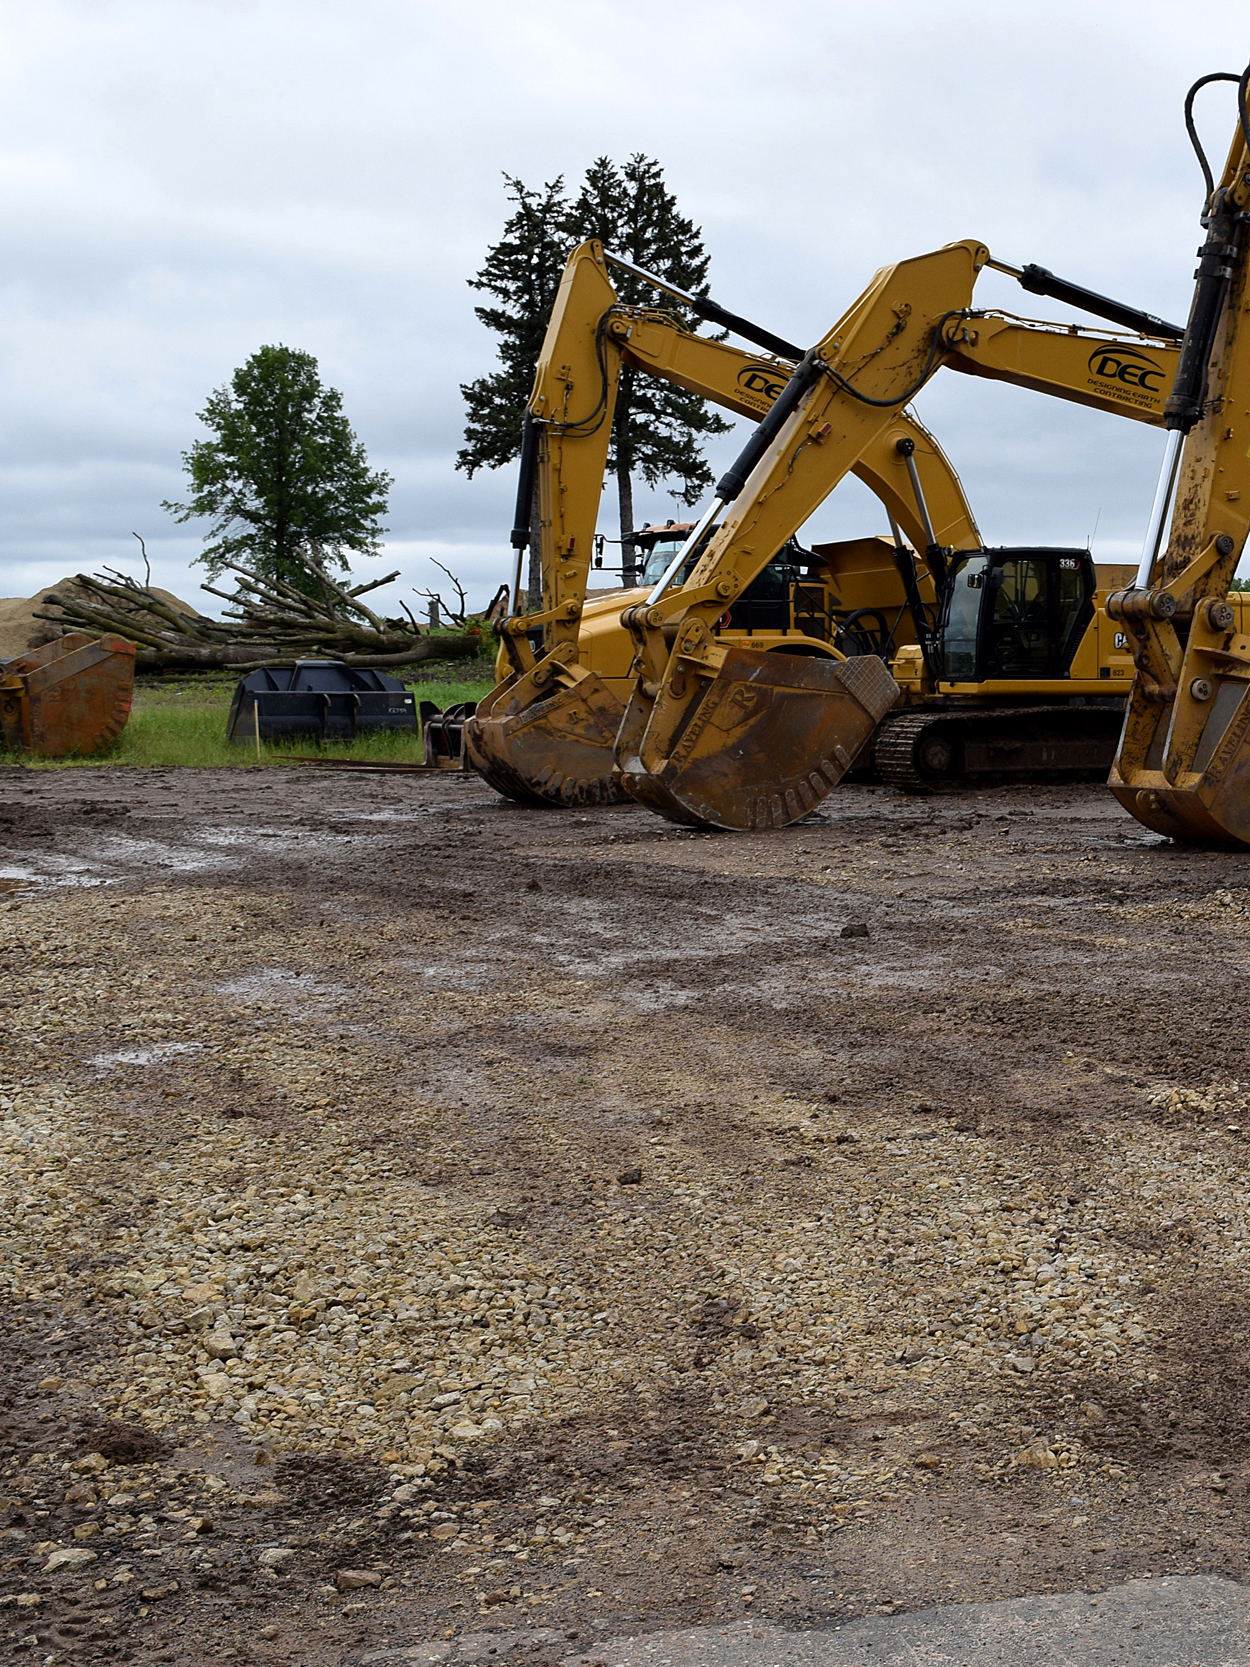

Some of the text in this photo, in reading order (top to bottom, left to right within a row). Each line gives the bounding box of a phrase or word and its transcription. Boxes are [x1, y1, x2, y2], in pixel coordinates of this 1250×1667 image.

[743, 372, 785, 401] DE
[1096, 355, 1166, 392] DEC
[1087, 378, 1160, 404] DESIGNING EARTH
[1093, 387, 1152, 409] CONTRACTING
[1059, 558, 1075, 569] 336
[730, 687, 757, 712] R
[672, 699, 718, 763] RAVELING
